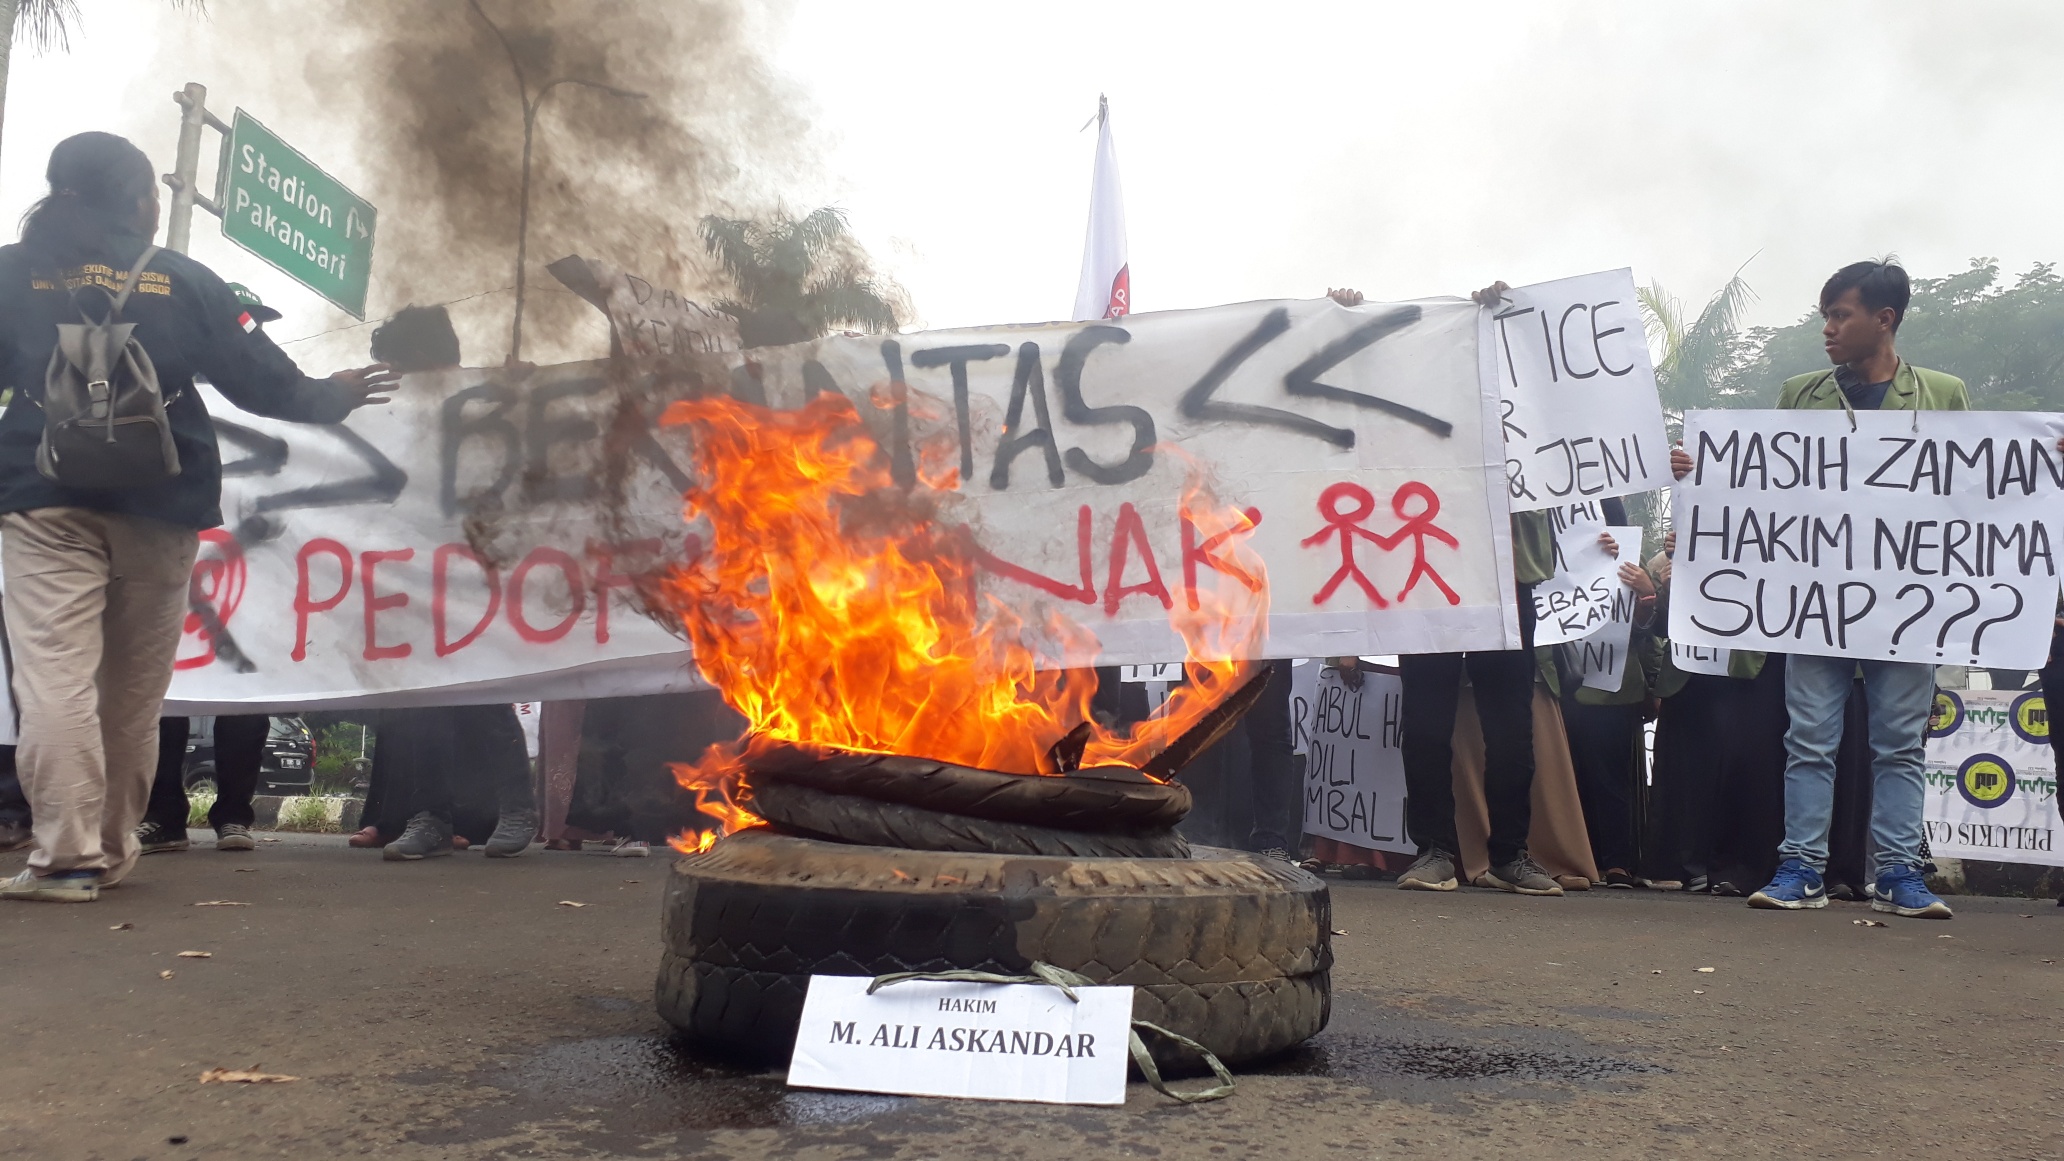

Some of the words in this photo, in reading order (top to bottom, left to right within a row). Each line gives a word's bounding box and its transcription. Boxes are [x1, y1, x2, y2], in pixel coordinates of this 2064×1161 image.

[241, 144, 332, 228] Stadion
[235, 187, 346, 281] Pakansari
[115, 271, 171, 284] MASISWA
[1535, 434, 1648, 498] JENI
[1695, 429, 1848, 491] MASIH
[1863, 438, 2064, 499] ZAMAN
[1688, 504, 1853, 571] HAKIM
[1874, 518, 2055, 577] NERIMA
[1690, 569, 1877, 649] SUAP
[1313, 686, 1371, 740] ABUL
[1308, 740, 1355, 786] DILI
[1958, 823, 2054, 852] PELUKIS
[938, 997, 997, 1014] HAKIM
[829, 1020, 861, 1045] M.
[870, 1023, 921, 1050] ALI
[926, 1026, 1096, 1058] ASKANDAR
